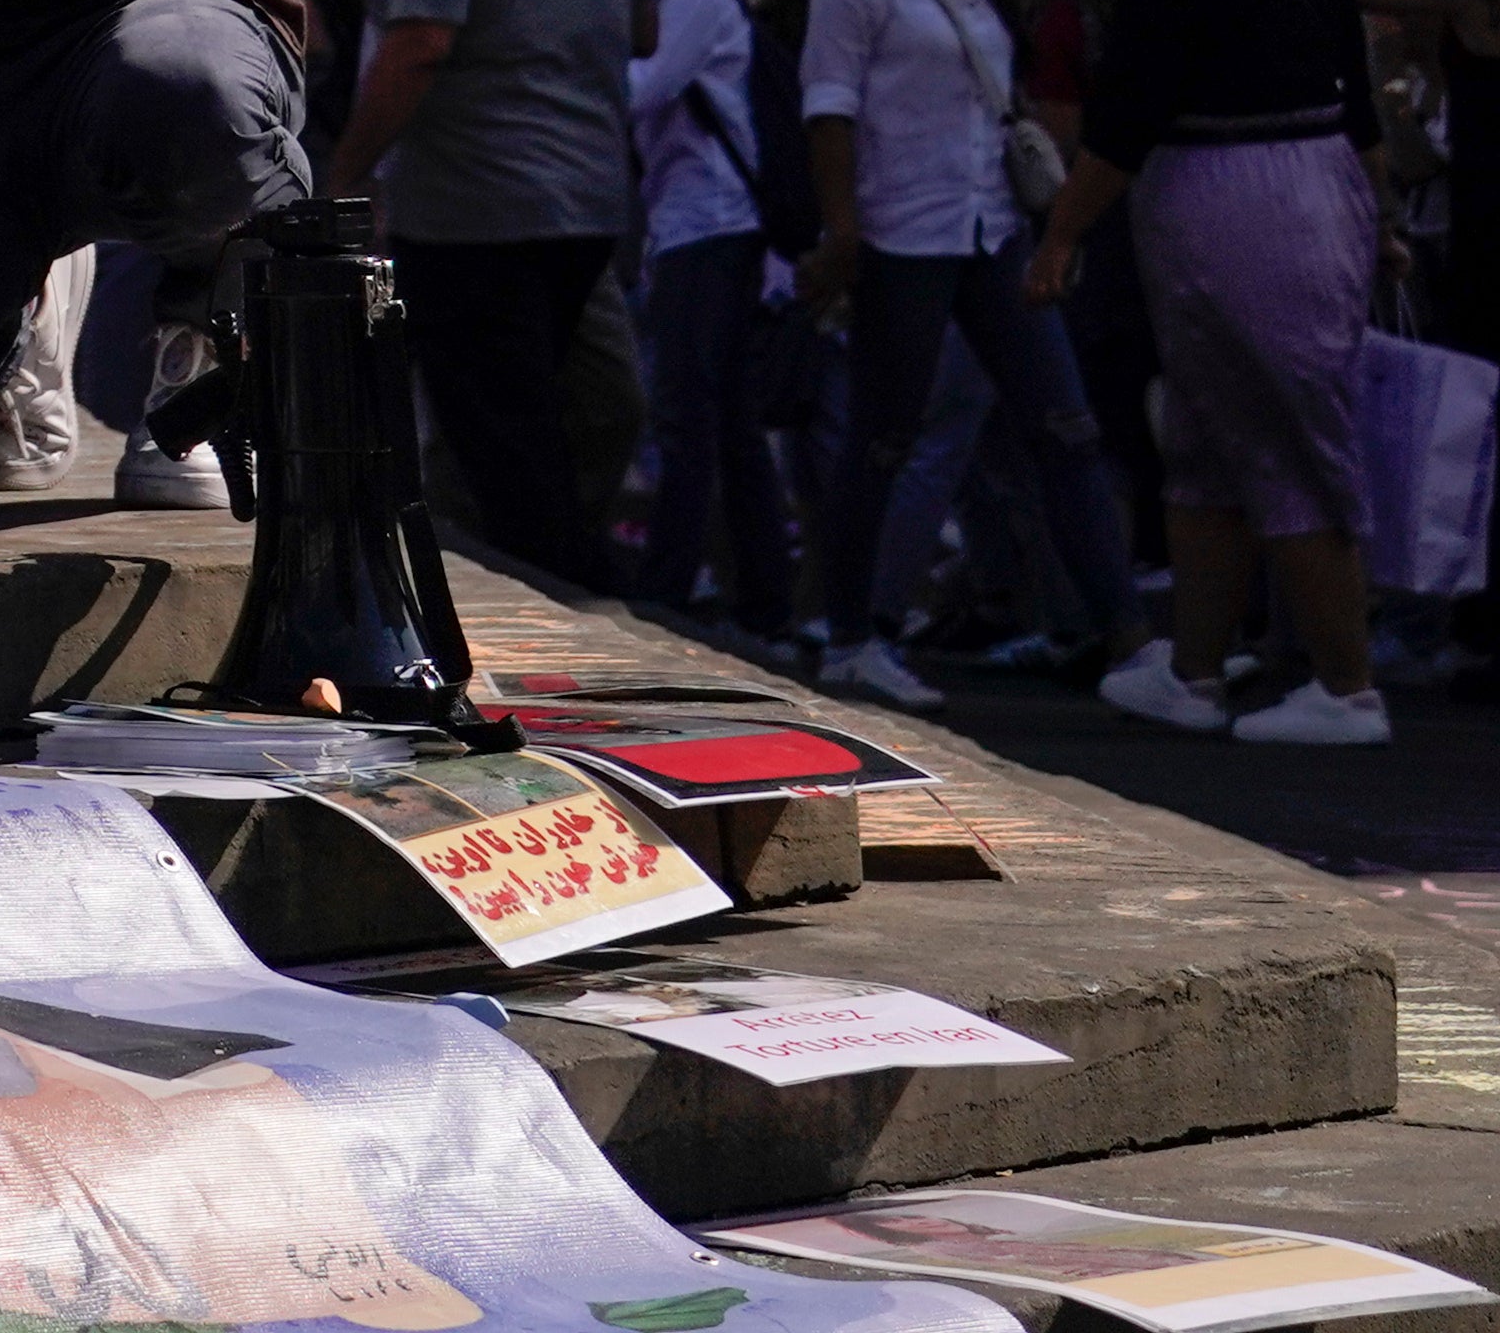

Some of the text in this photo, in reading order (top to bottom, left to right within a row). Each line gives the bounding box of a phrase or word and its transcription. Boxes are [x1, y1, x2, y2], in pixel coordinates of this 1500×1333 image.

[723, 1025, 1000, 1060] Torture en Iran
